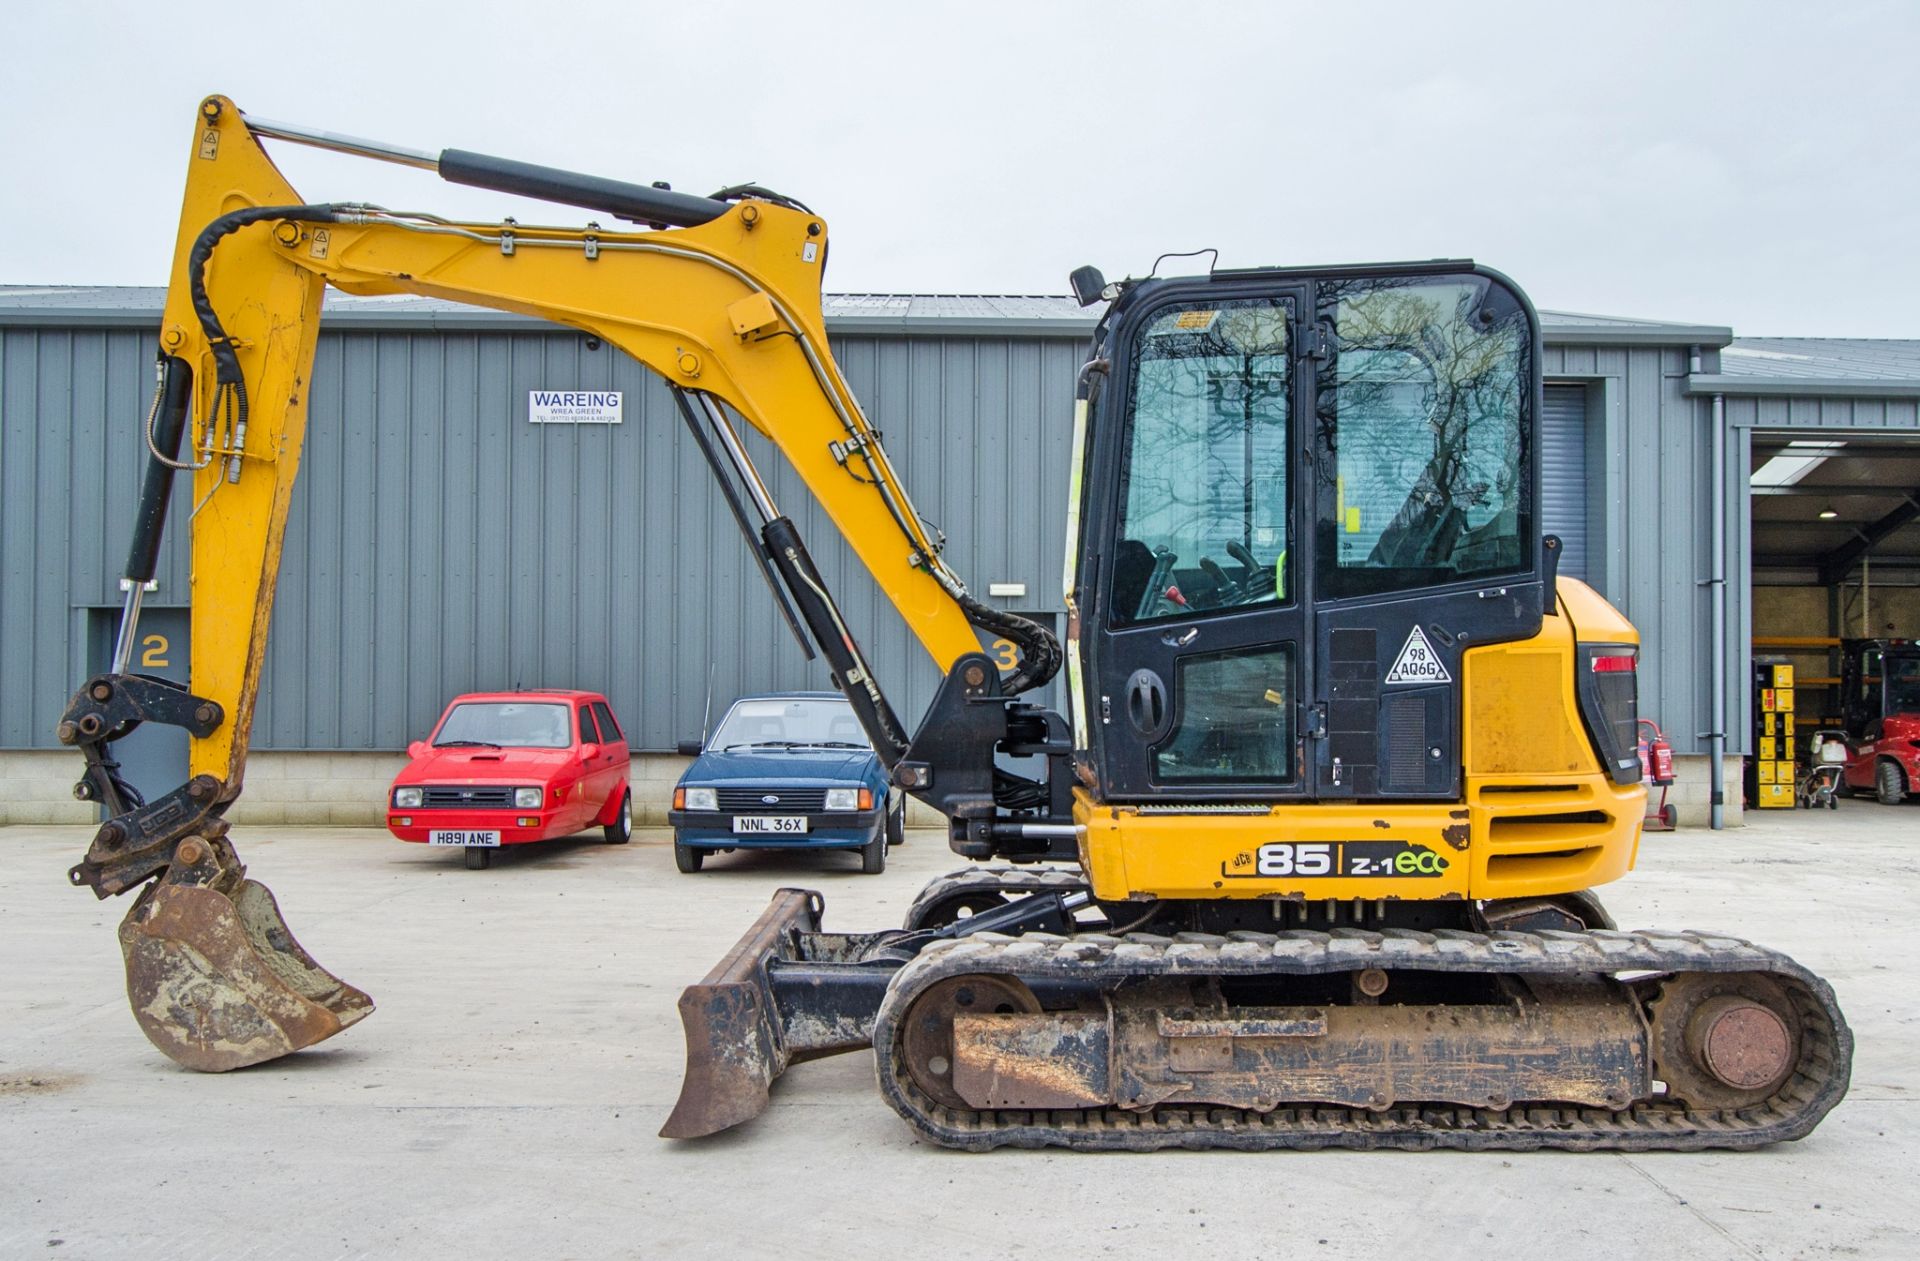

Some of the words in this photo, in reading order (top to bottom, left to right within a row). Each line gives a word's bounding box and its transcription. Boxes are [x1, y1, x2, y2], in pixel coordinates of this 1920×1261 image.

[534, 393, 618, 407] WAREING
[142, 635, 169, 667] 2
[992, 639, 1018, 671] 3
[1409, 648, 1426, 661] 98
[1401, 662, 1436, 676] AQ6G
[740, 818, 769, 831] NNL
[774, 818, 802, 831] 36X
[468, 832, 494, 844] ANE
[1233, 852, 1252, 867] JCB
[1258, 843, 1331, 875] 85
